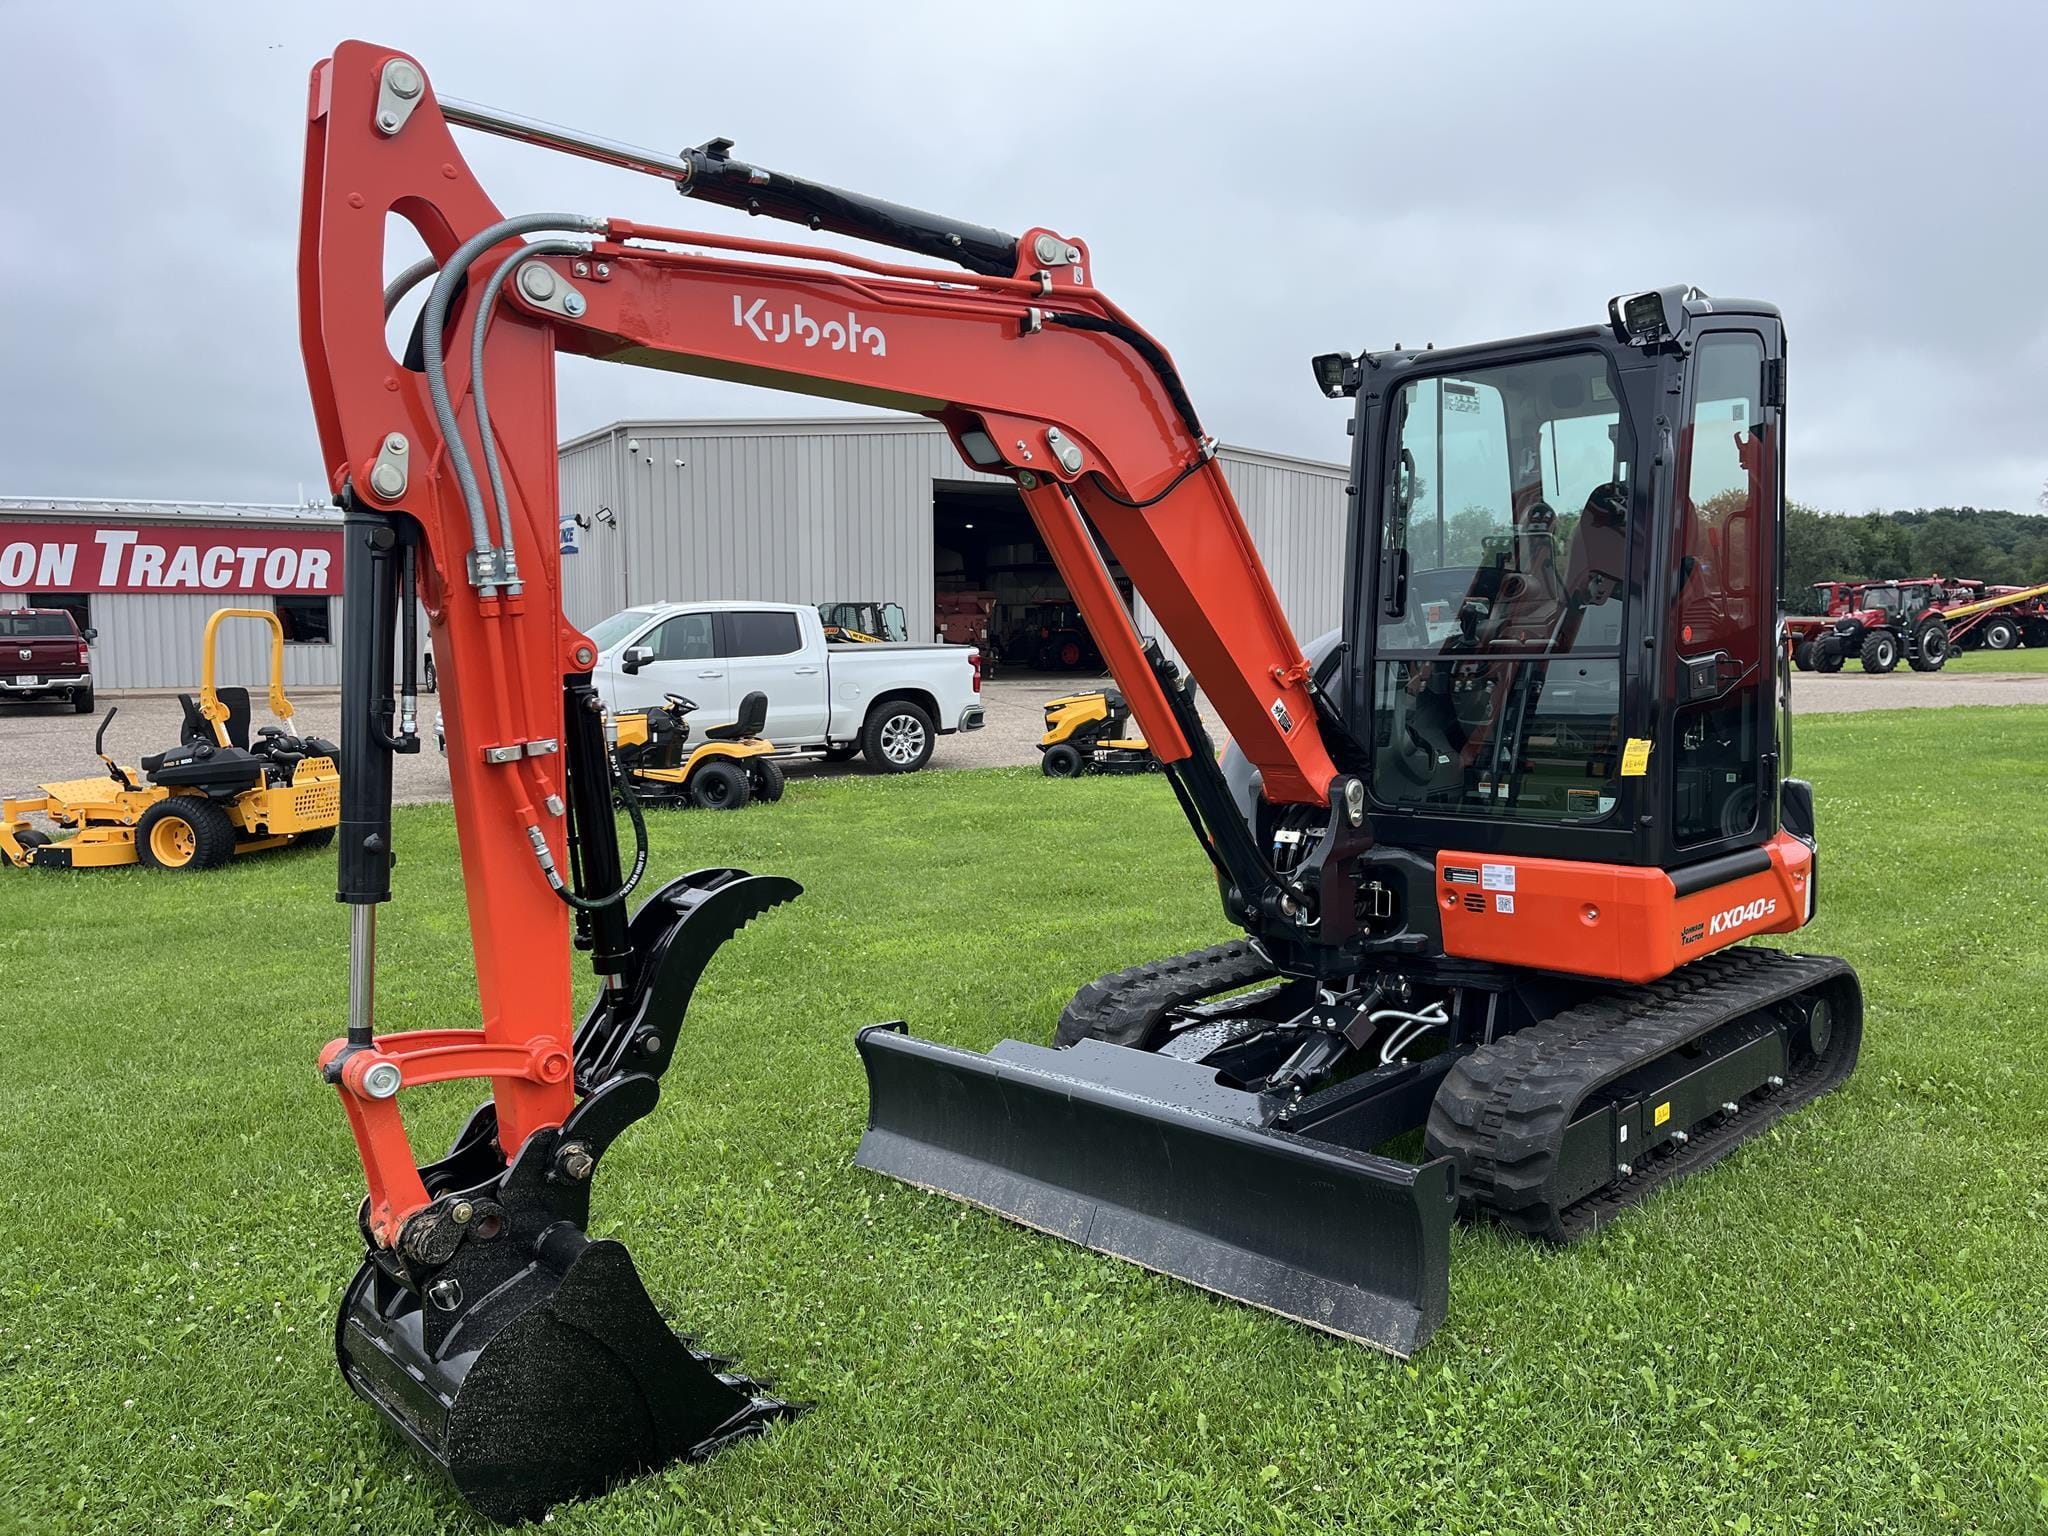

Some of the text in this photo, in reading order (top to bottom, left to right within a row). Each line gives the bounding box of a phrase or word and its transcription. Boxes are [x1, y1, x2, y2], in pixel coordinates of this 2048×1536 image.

[733, 294, 886, 357] Kubota
[0, 529, 331, 589] ON TRACTOR
